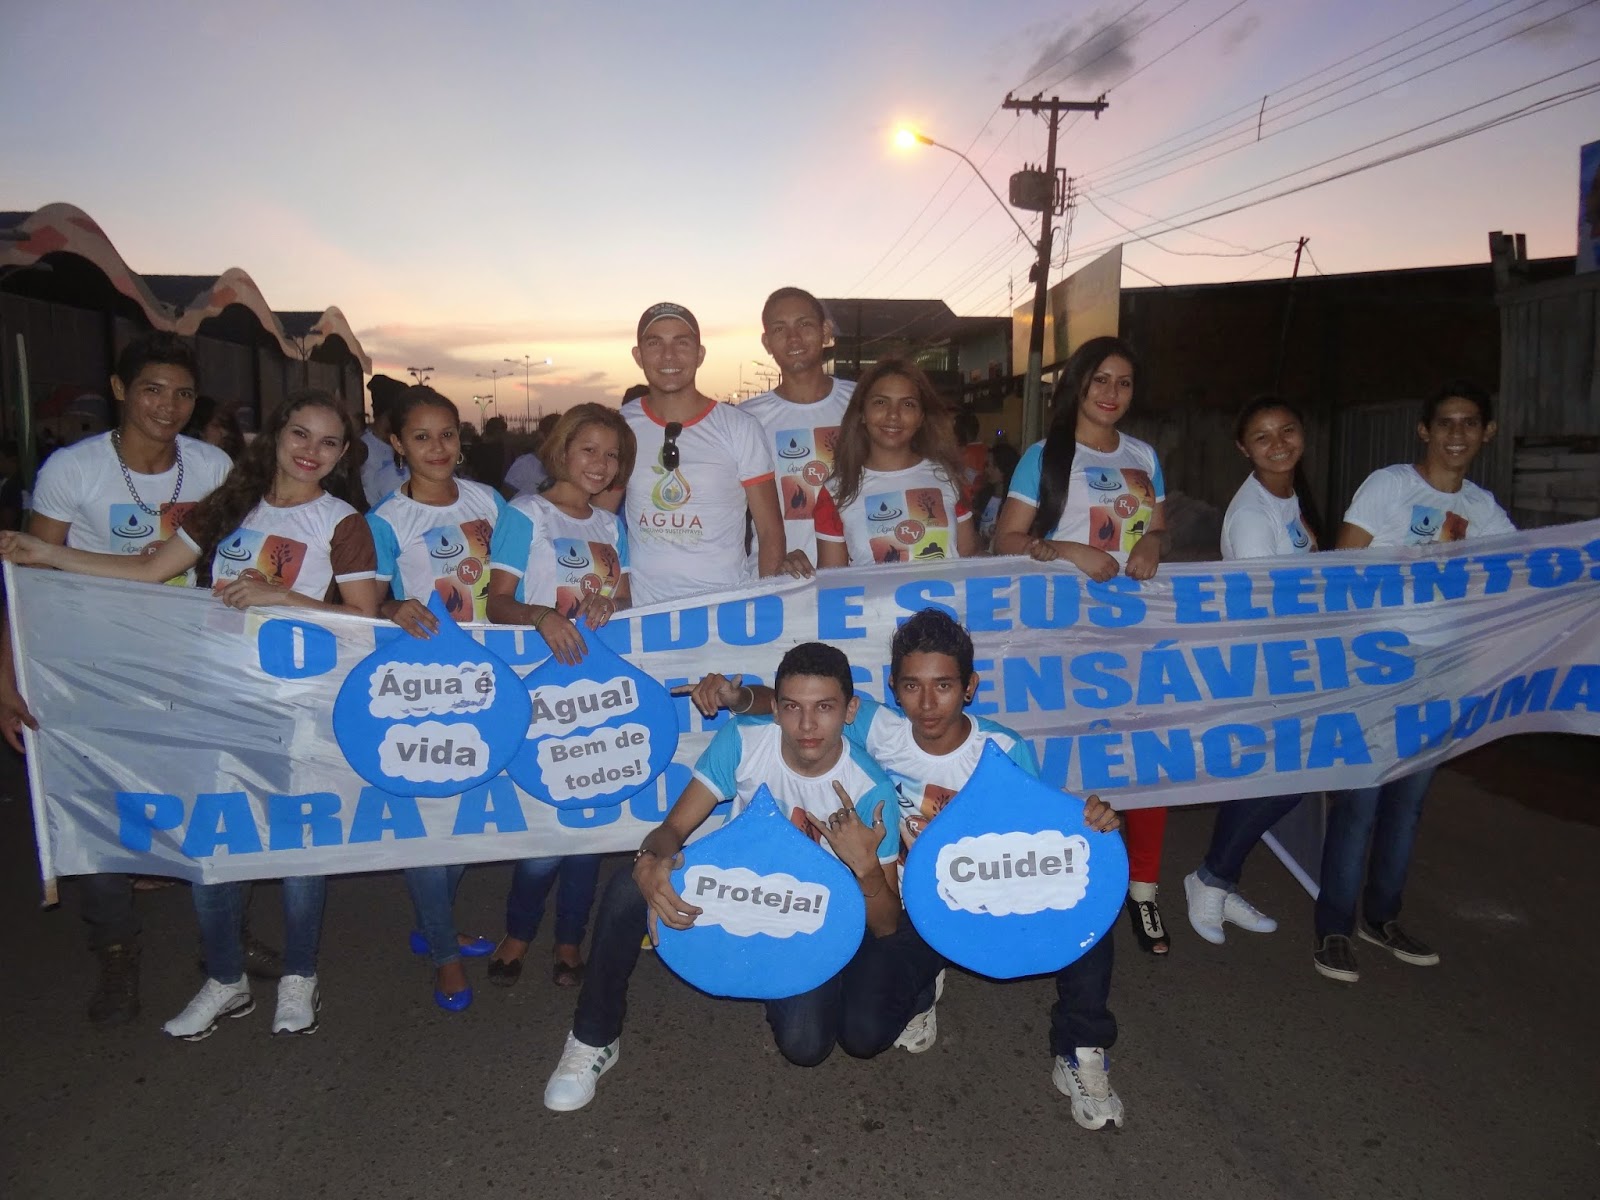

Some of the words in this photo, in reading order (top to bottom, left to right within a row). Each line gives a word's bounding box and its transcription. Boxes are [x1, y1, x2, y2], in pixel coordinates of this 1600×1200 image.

[639, 508, 703, 529] ÁGUA
[257, 618, 337, 680] O
[817, 586, 868, 640] E
[894, 574, 1147, 632] SEUS
[378, 668, 463, 701] Água
[475, 671, 493, 694] é
[531, 680, 634, 725] Água!
[396, 738, 477, 767] vida
[551, 739, 607, 763] Bem
[615, 731, 645, 749] de
[565, 759, 643, 790] todos!
[115, 785, 428, 858] PARA
[949, 847, 1075, 883] Cuide!
[696, 875, 823, 914] Proteja!
